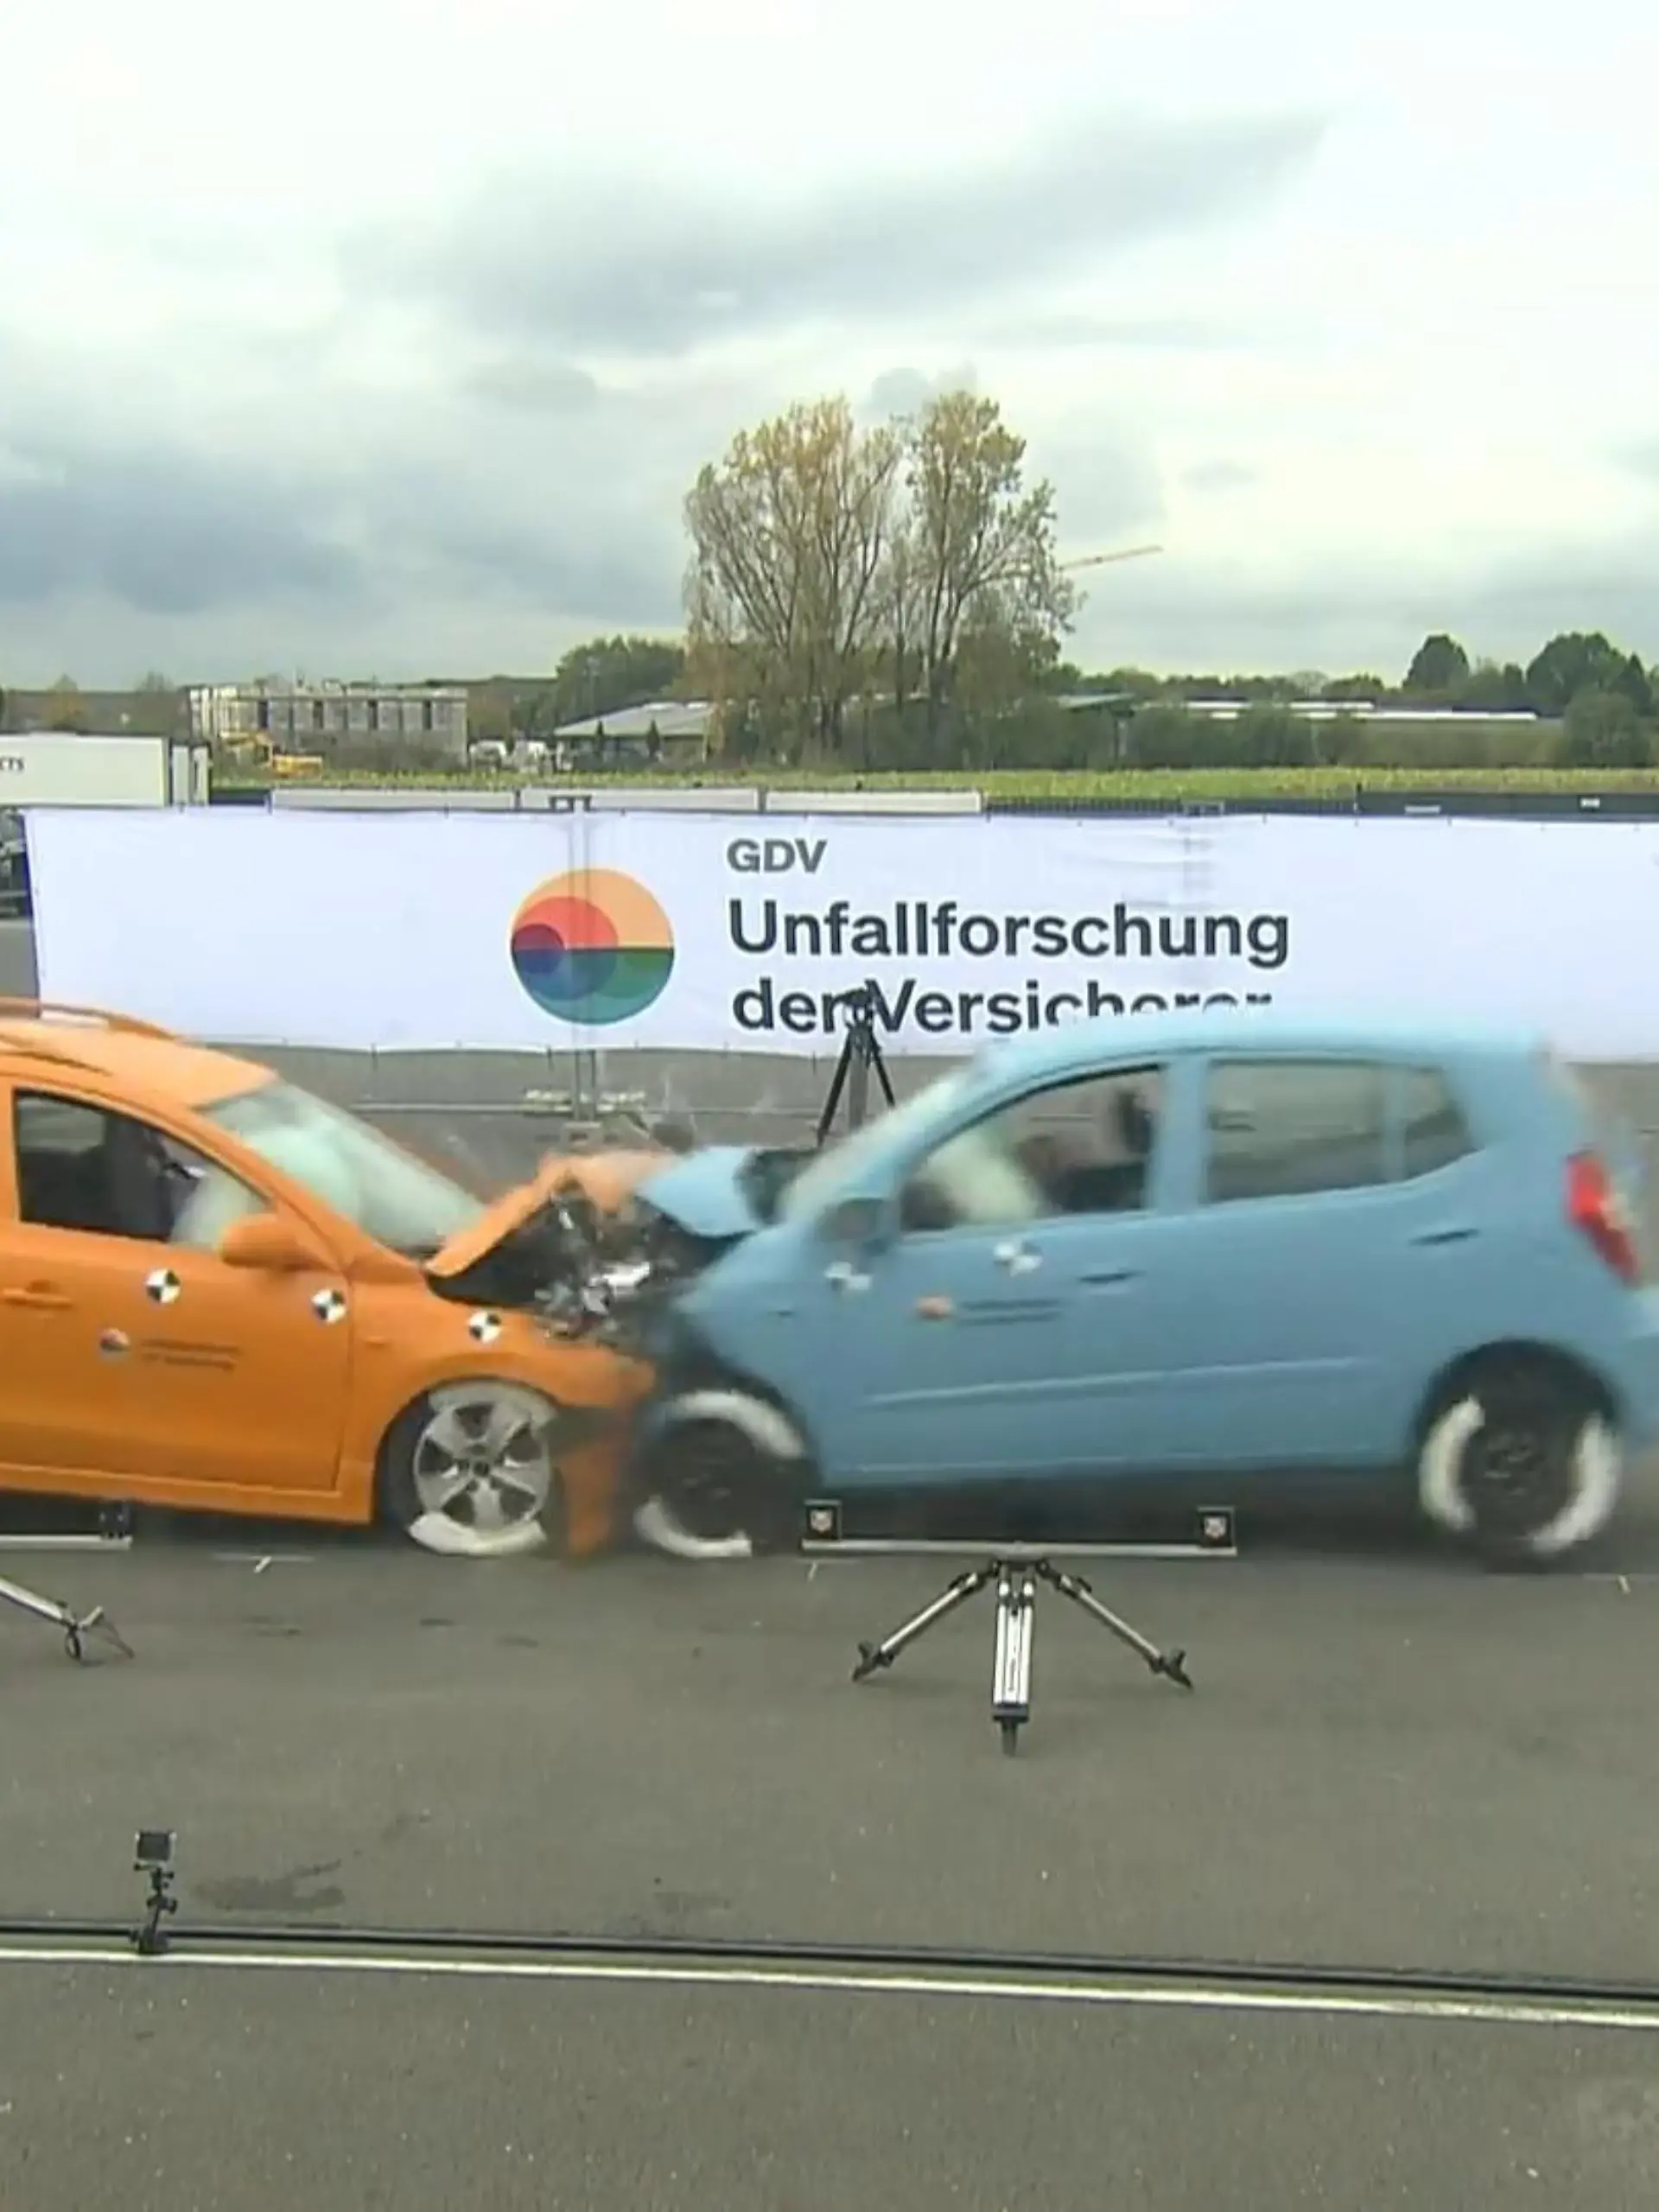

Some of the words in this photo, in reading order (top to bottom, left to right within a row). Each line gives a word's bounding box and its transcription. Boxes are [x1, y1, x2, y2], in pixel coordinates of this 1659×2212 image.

[727, 839, 827, 873] GDV
[729, 899, 1289, 969] Unfallforschung
[733, 977, 851, 1033] der
